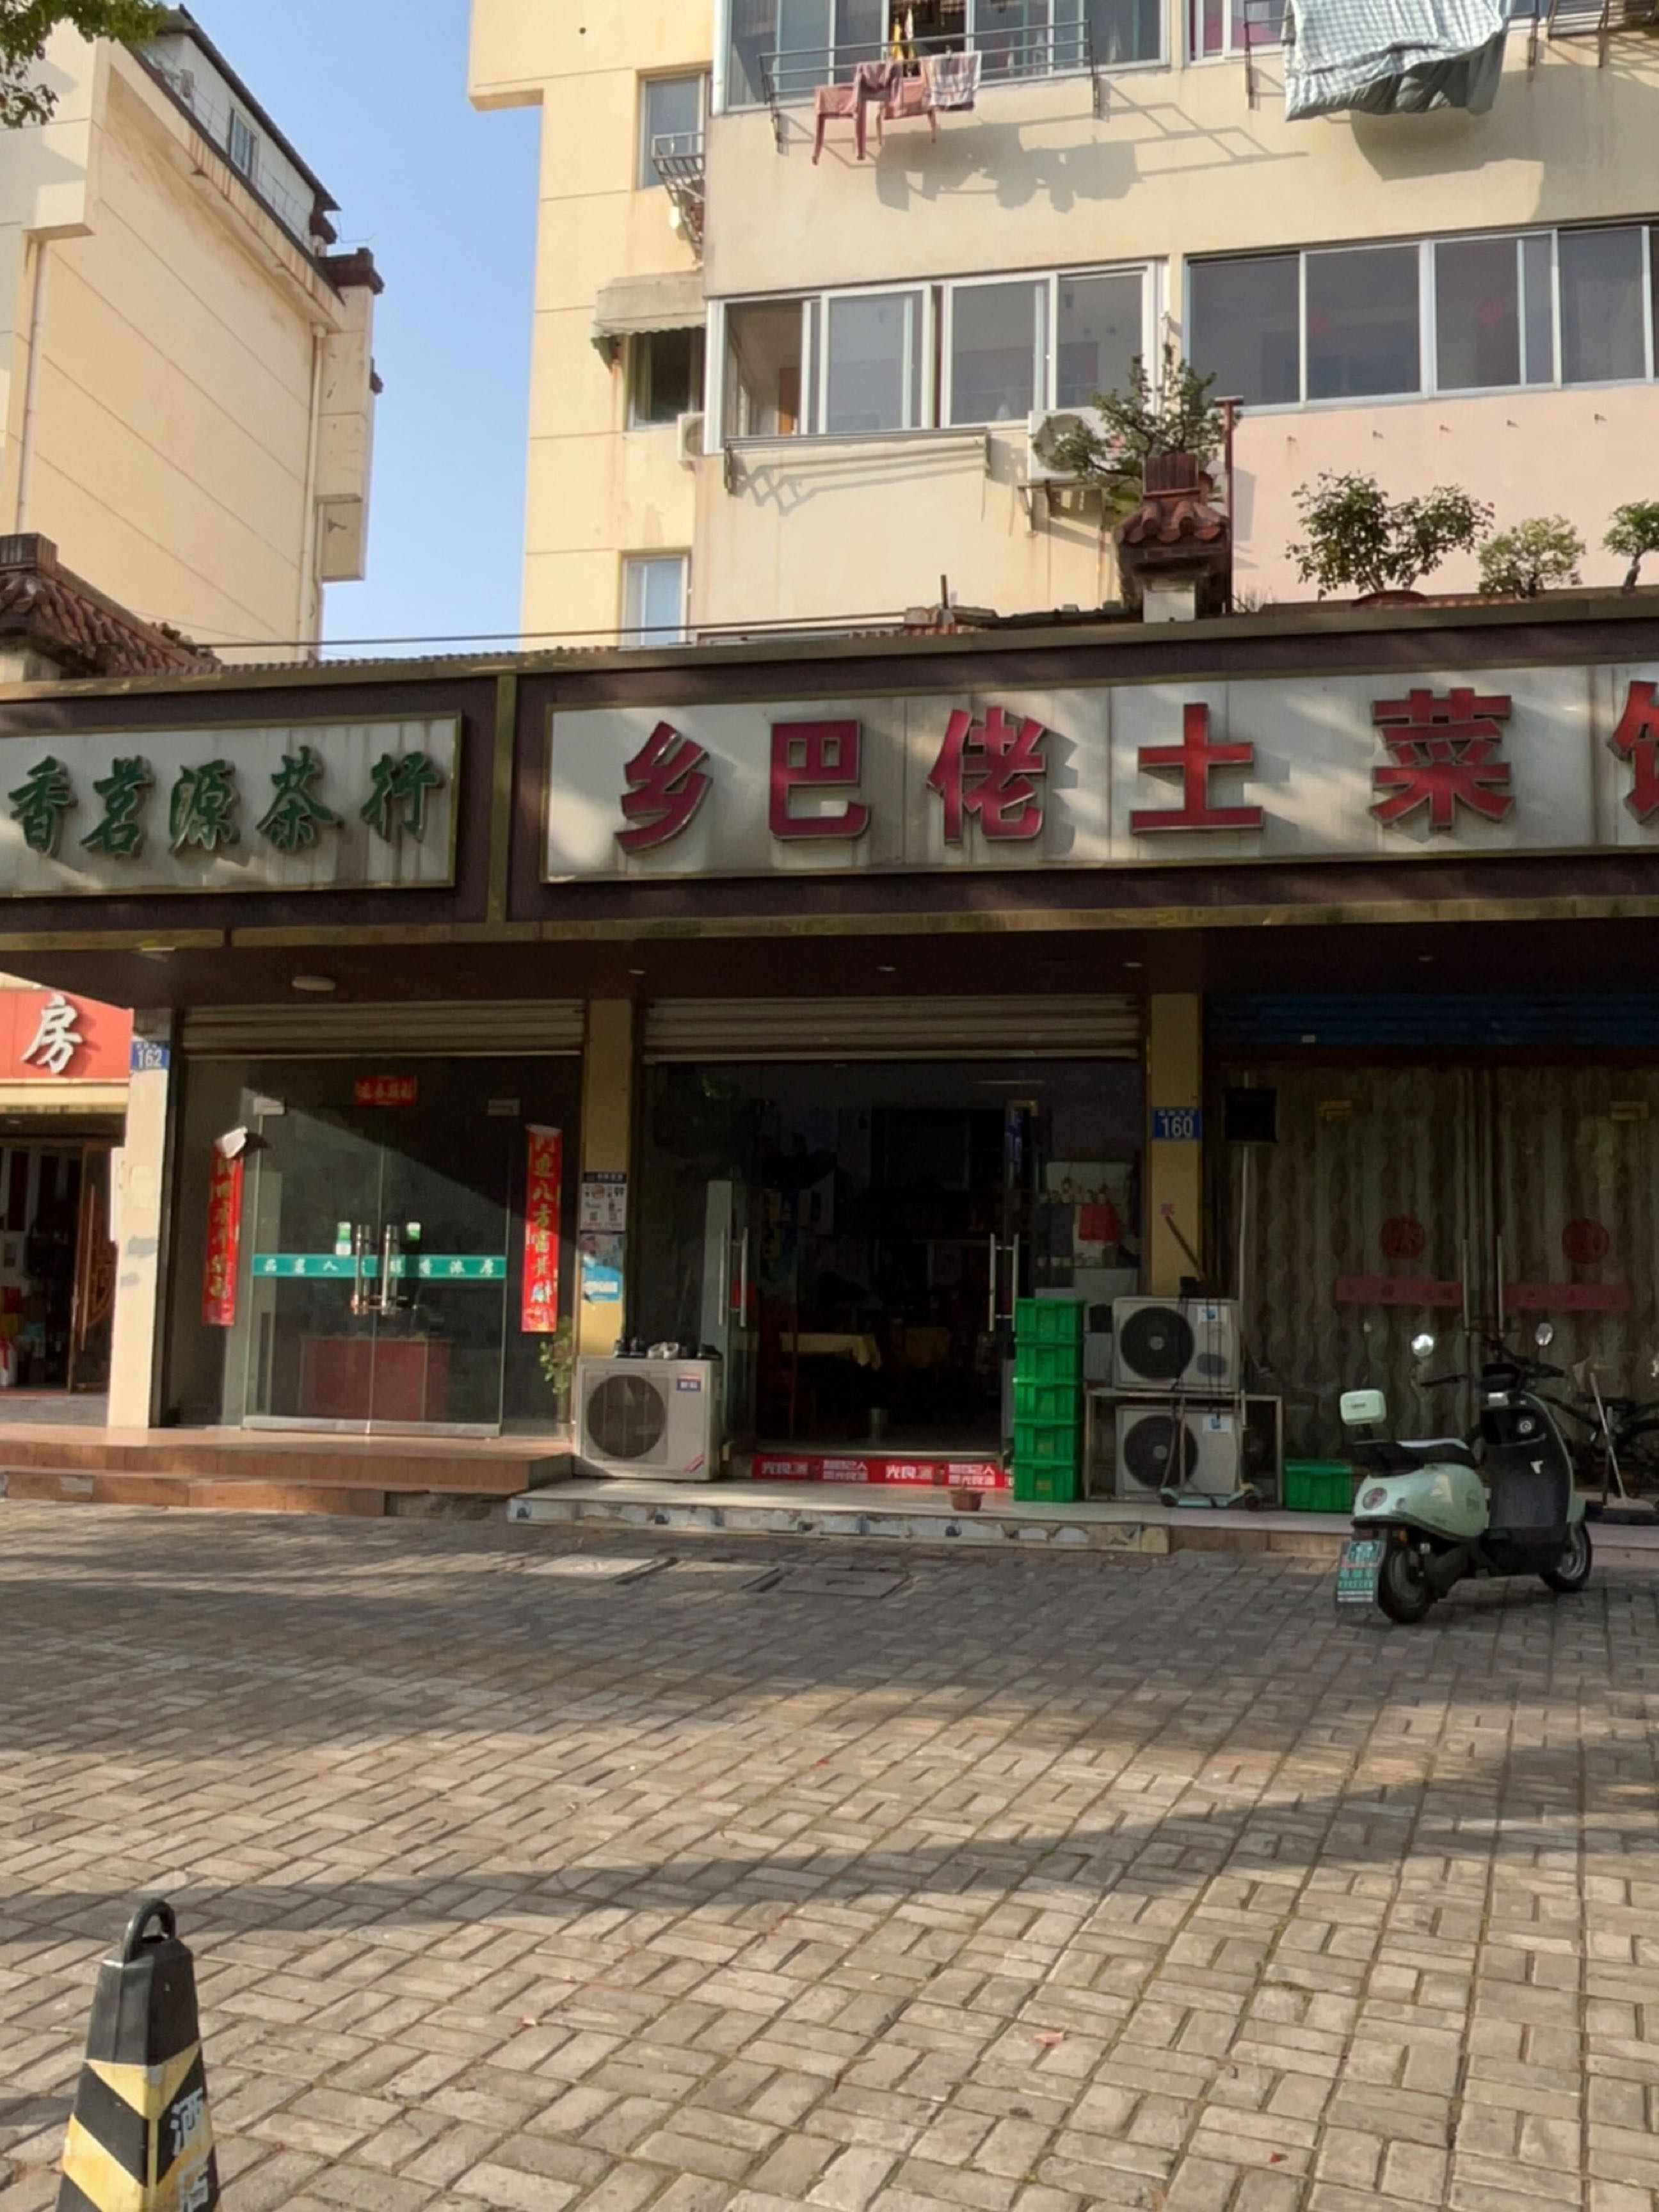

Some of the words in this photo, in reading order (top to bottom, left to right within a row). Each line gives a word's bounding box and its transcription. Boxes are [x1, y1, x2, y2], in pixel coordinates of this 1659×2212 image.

[9, 746, 445, 859] 香茗源茶行
[21, 994, 84, 1075] 房
[138, 1048, 163, 1068] 162
[1162, 1116, 1194, 1138] 160
